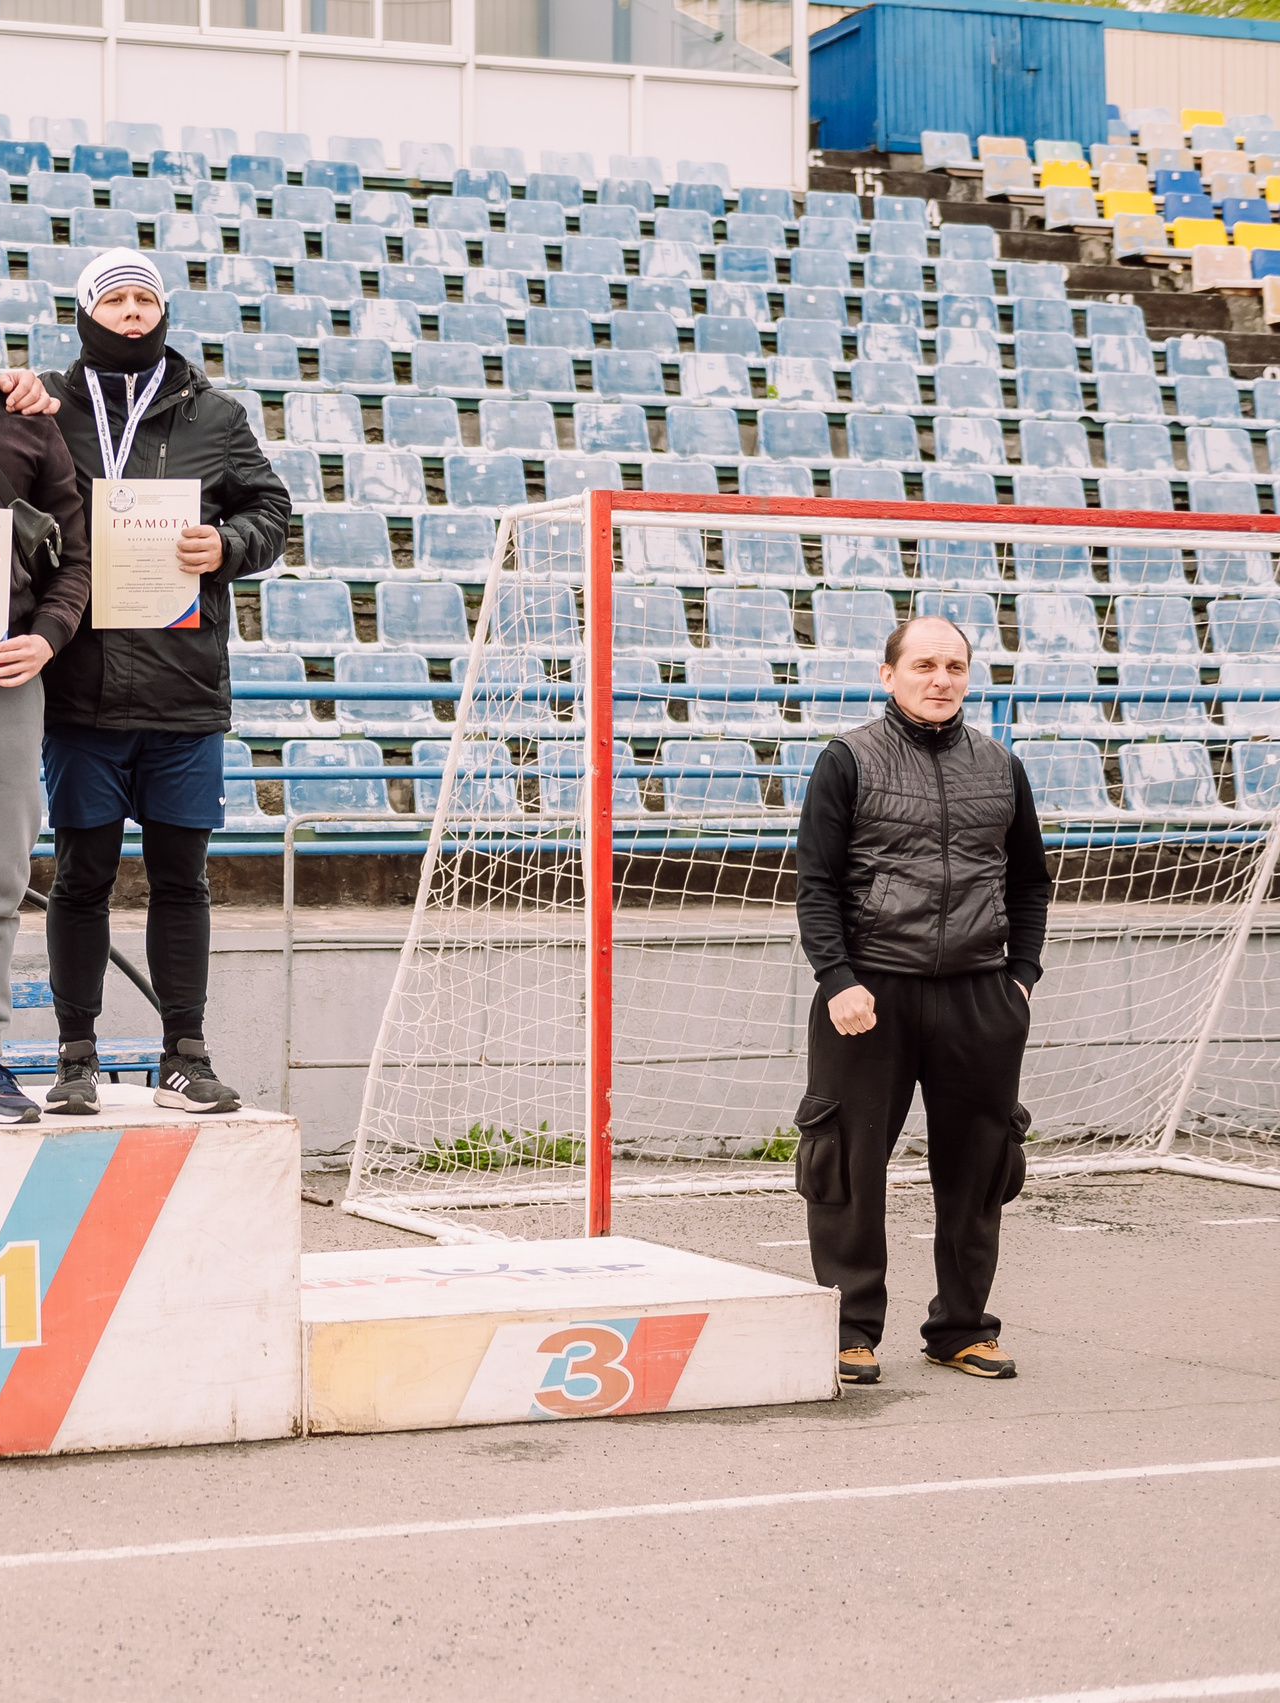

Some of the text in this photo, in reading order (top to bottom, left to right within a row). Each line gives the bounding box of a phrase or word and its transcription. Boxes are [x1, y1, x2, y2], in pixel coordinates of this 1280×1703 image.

[851, 167, 884, 197] 15
[113, 518, 191, 529] ГРАМОТА
[532, 1320, 635, 1418] 3
